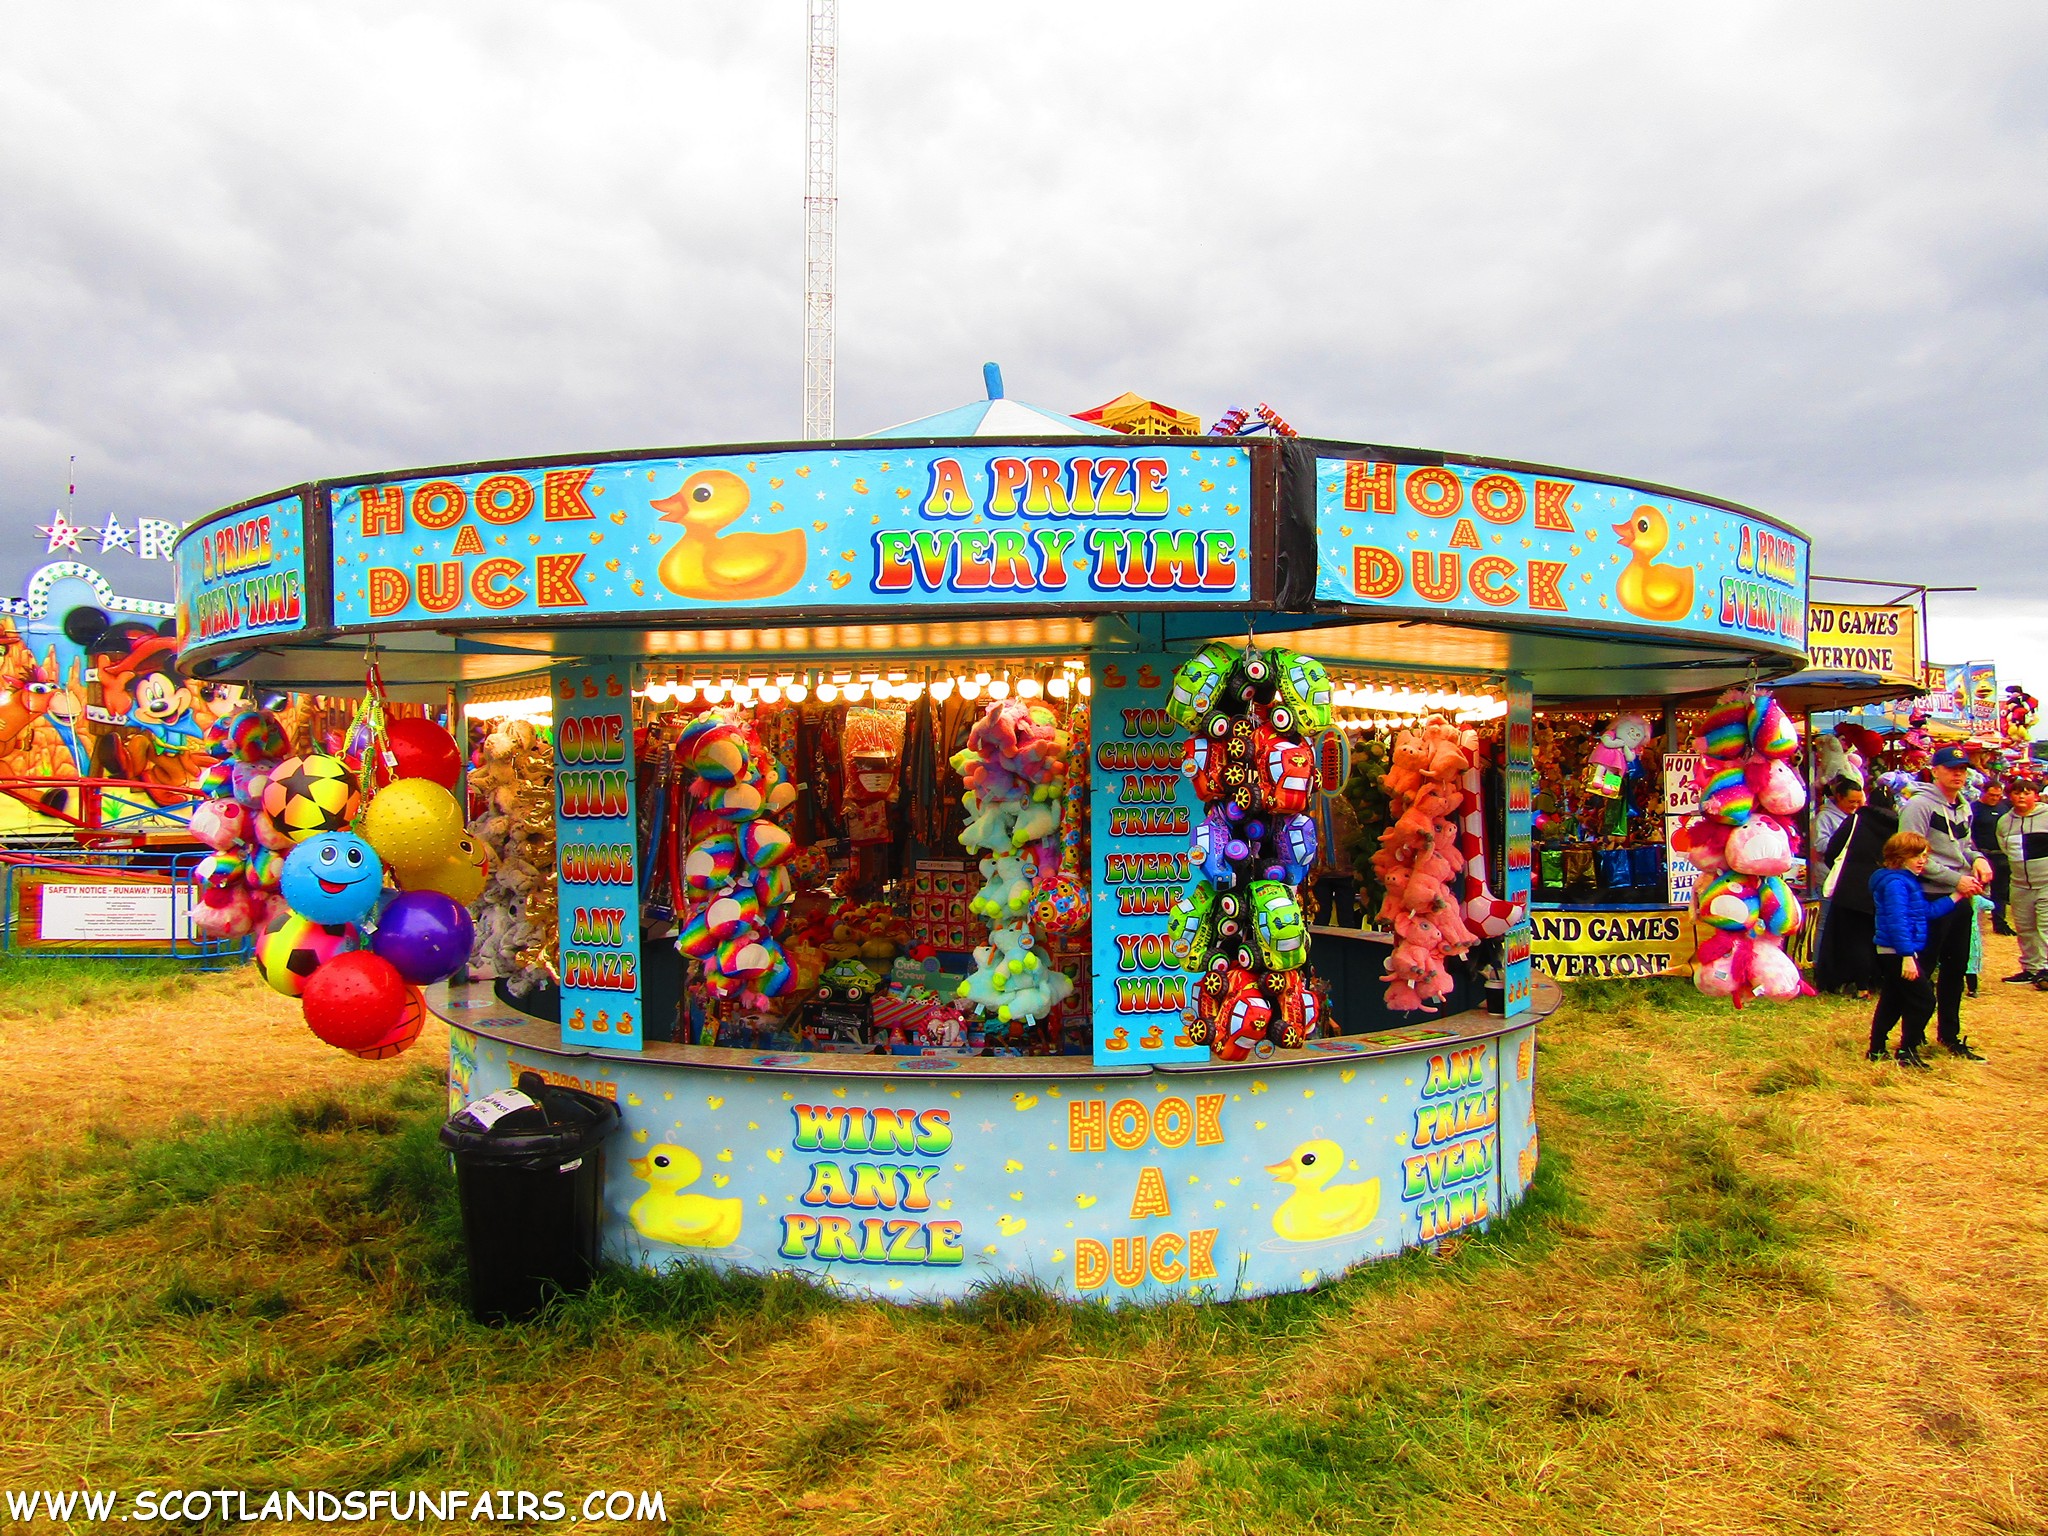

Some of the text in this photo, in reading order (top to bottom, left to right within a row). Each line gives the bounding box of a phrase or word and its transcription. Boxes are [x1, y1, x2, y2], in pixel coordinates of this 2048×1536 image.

[360, 468, 597, 537] HOOK
[919, 456, 1169, 521] A PRIZE
[1344, 459, 1575, 532] HOOK
[203, 514, 273, 582] A PRIZE
[451, 524, 486, 556] A
[1449, 518, 1483, 550] A
[1736, 524, 1796, 589] A PRIZE
[368, 553, 588, 617] DUCK
[870, 528, 1238, 593] EVERY TIME
[1352, 545, 1569, 611] DUCK
[197, 569, 301, 639] EVERY TIME
[1719, 576, 1779, 636] EVERY
[1808, 608, 1899, 636] ND GAMES
[1808, 646, 1893, 671] VERYONE
[559, 714, 626, 765] ONE
[1121, 708, 1177, 738] YOU
[1098, 740, 1185, 771] CHOOS
[560, 768, 628, 818] WIN
[1119, 774, 1178, 804] ANY
[1109, 806, 1190, 836] PRIZE
[561, 843, 635, 885] CHOOSE
[1105, 853, 1192, 882] EVERY
[1671, 861, 1700, 872] PRIZ
[48, 886, 78, 894] SAFETY
[80, 886, 107, 894] NOTICE
[113, 886, 150, 894] RUNAWAY
[1116, 886, 1183, 916] TIME
[573, 906, 625, 947] ANY
[1588, 917, 1680, 942] GAMES
[564, 951, 637, 992] PRIZE
[895, 959, 921, 970] Cute
[896, 970, 926, 980] Crew
[1115, 933, 1180, 971] YOU
[1115, 976, 1188, 1014] WIN
[1421, 1044, 1486, 1100] ANY
[791, 1104, 954, 1156] WINS
[1068, 1093, 1226, 1152] HOOK
[1412, 1086, 1497, 1149] PRIZE
[800, 1161, 941, 1212] ANY
[1401, 1131, 1496, 1202] EVERY
[1129, 1166, 1171, 1219] A
[1415, 1180, 1489, 1244] TIME
[778, 1214, 965, 1267] PRIZE
[1074, 1228, 1219, 1290] DUCK
